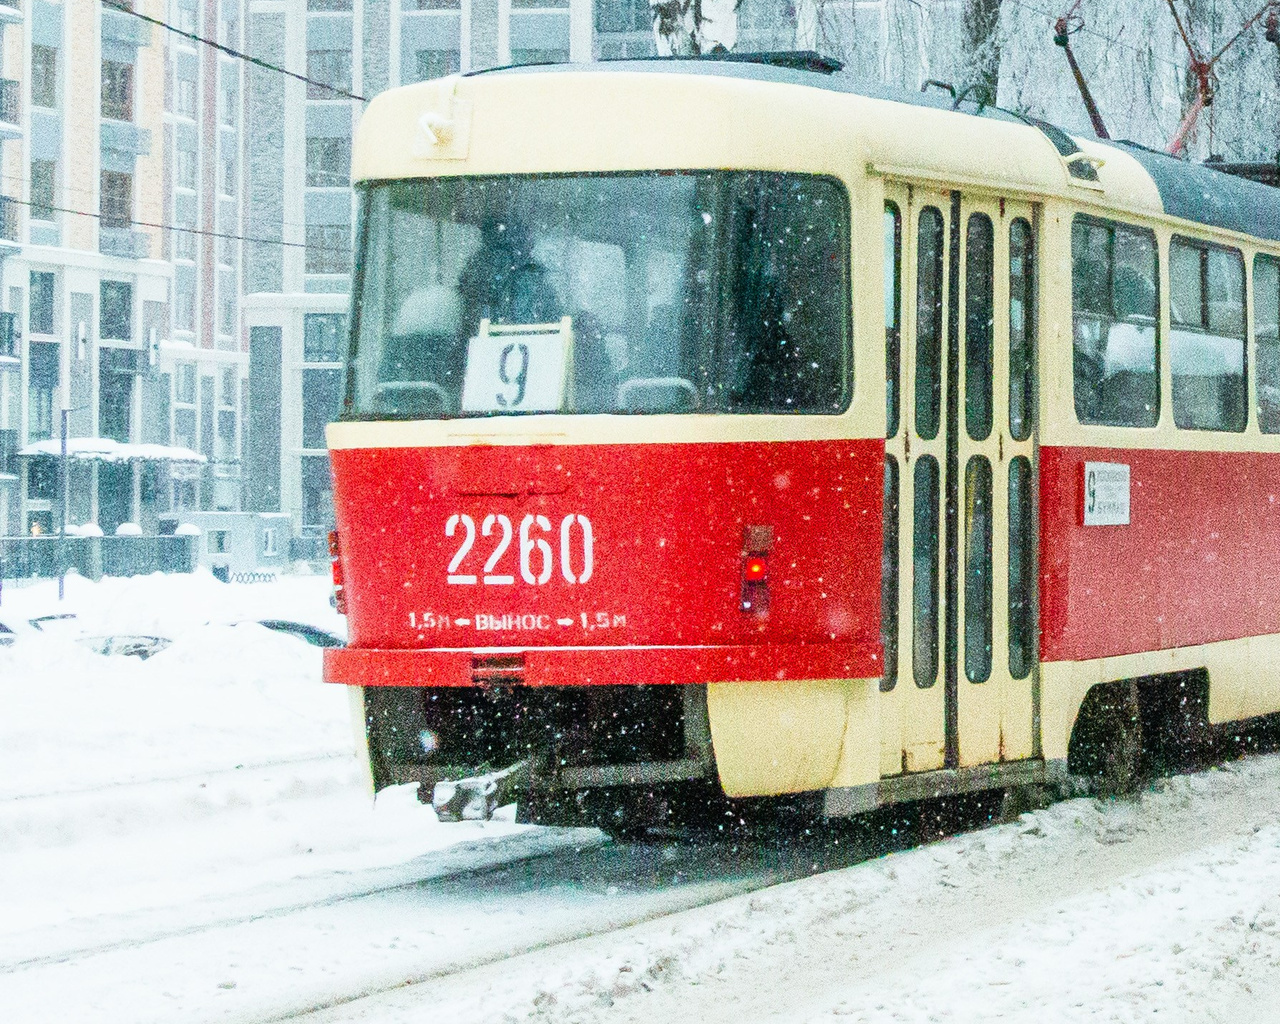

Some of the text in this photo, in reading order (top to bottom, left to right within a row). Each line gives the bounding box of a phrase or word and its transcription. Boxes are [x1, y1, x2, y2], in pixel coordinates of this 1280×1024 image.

[496, 343, 529, 406] 9
[1088, 471, 1095, 513] 9
[445, 513, 594, 585] 2260
[475, 613, 550, 631] ВЫНОС
